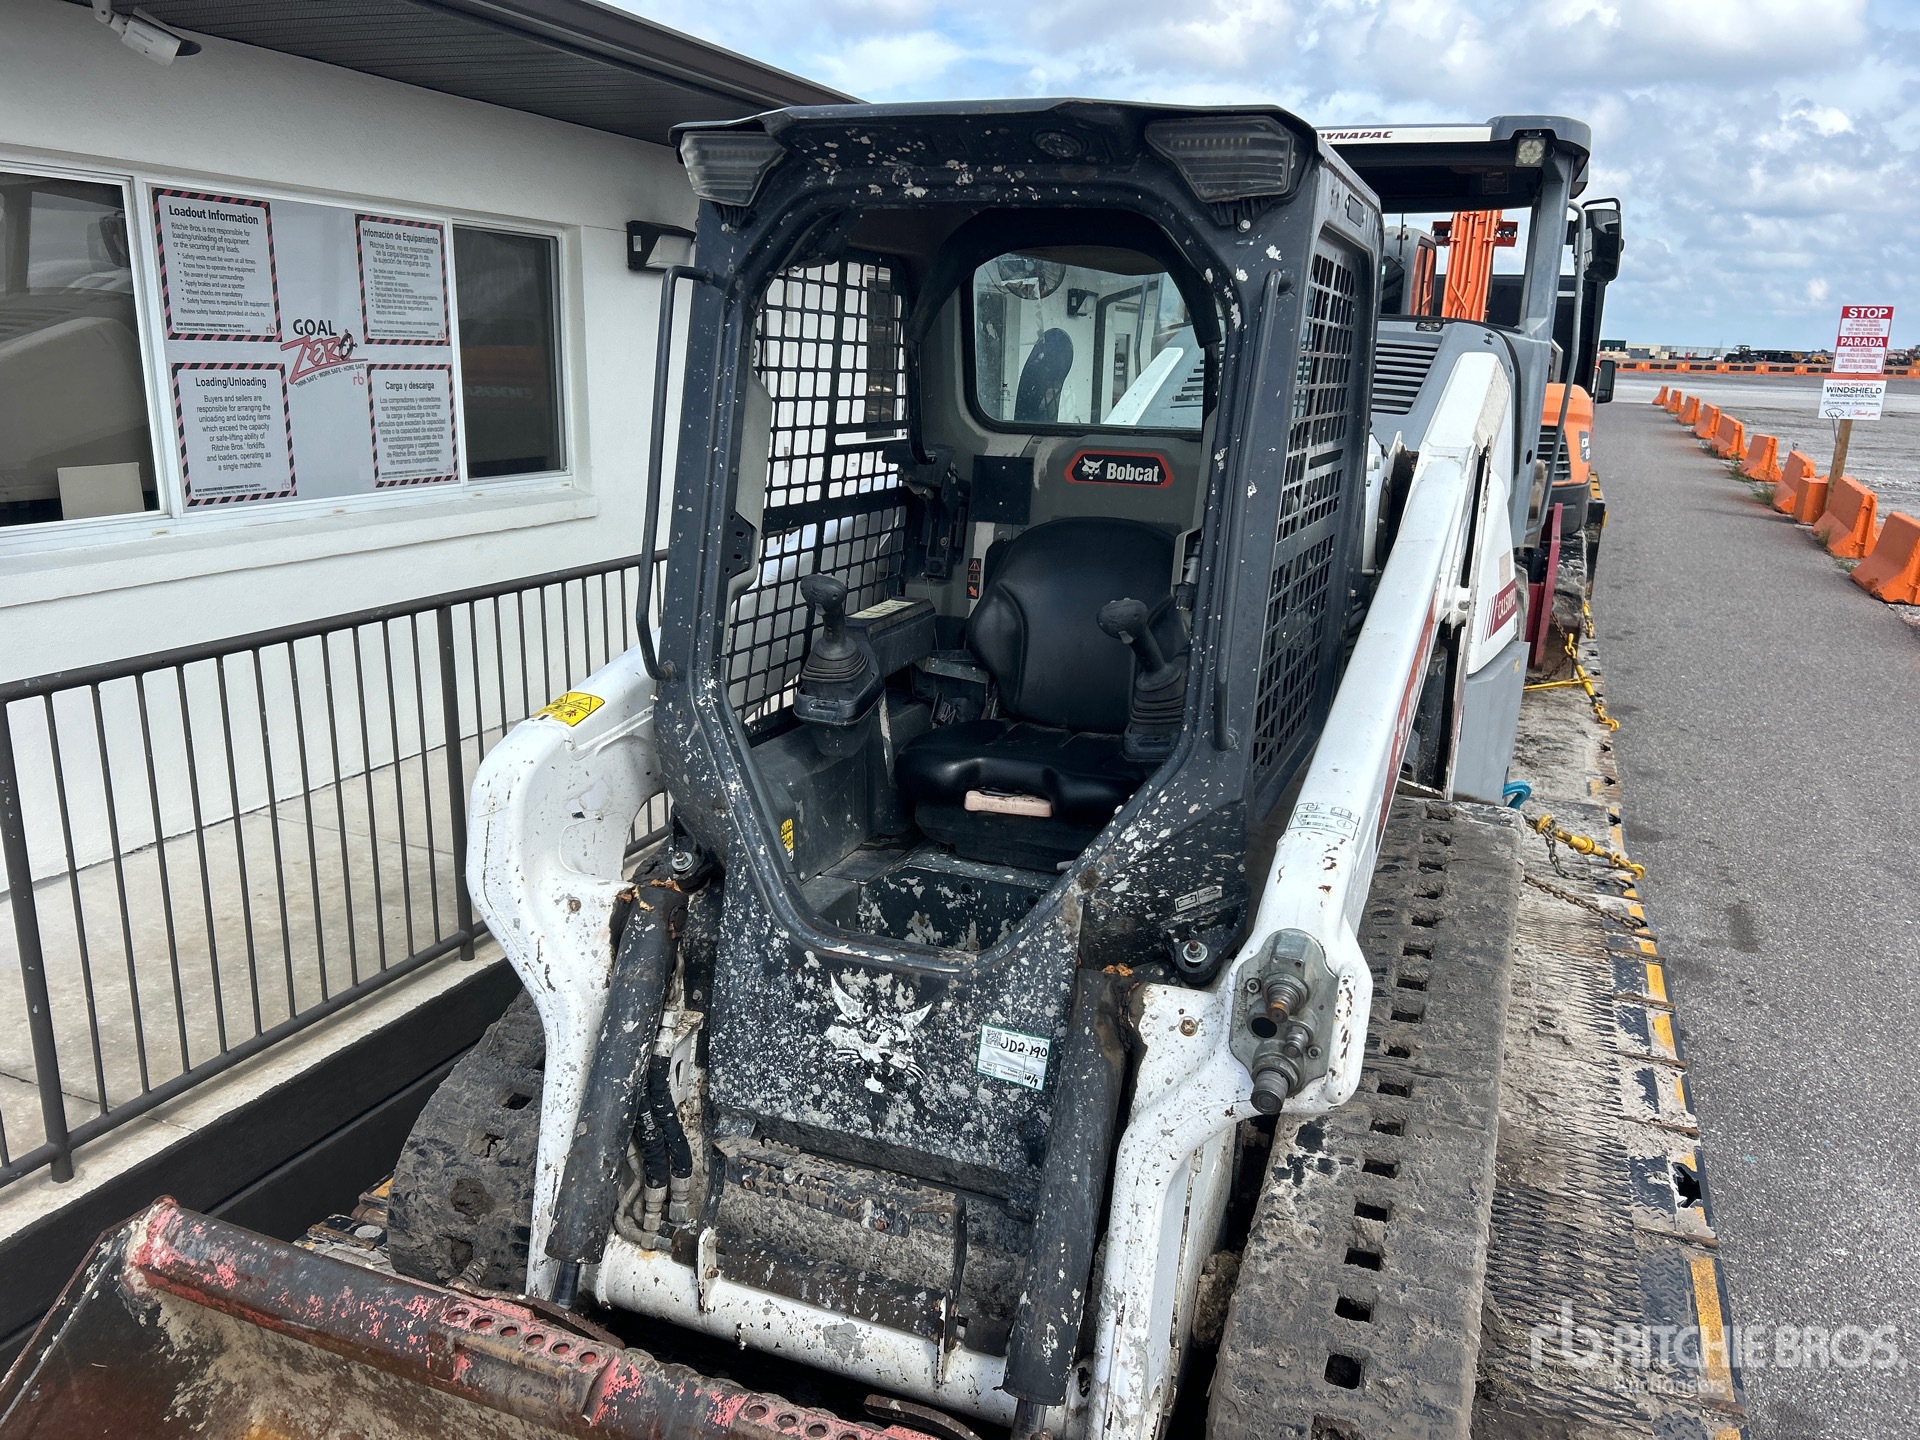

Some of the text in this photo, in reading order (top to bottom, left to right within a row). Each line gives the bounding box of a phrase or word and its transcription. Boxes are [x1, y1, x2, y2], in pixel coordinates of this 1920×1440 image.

[169, 205, 258, 224] Loadout Information
[403, 233, 438, 246] Equipamiento
[1848, 308, 1888, 318] STOP
[293, 318, 337, 336] GOAL
[1840, 337, 1884, 346] PARADA
[196, 377, 267, 388] Loading/Unloading
[352, 371, 364, 386] rb
[386, 382, 402, 392] Carga
[409, 382, 434, 391] descarga
[204, 395, 223, 404] Buyers
[199, 416, 225, 424] unloading
[240, 452, 264, 461] operating
[223, 464, 239, 472] single
[1106, 462, 1159, 482] Bobcat
[1000, 1037, 1048, 1058] JD2-190
